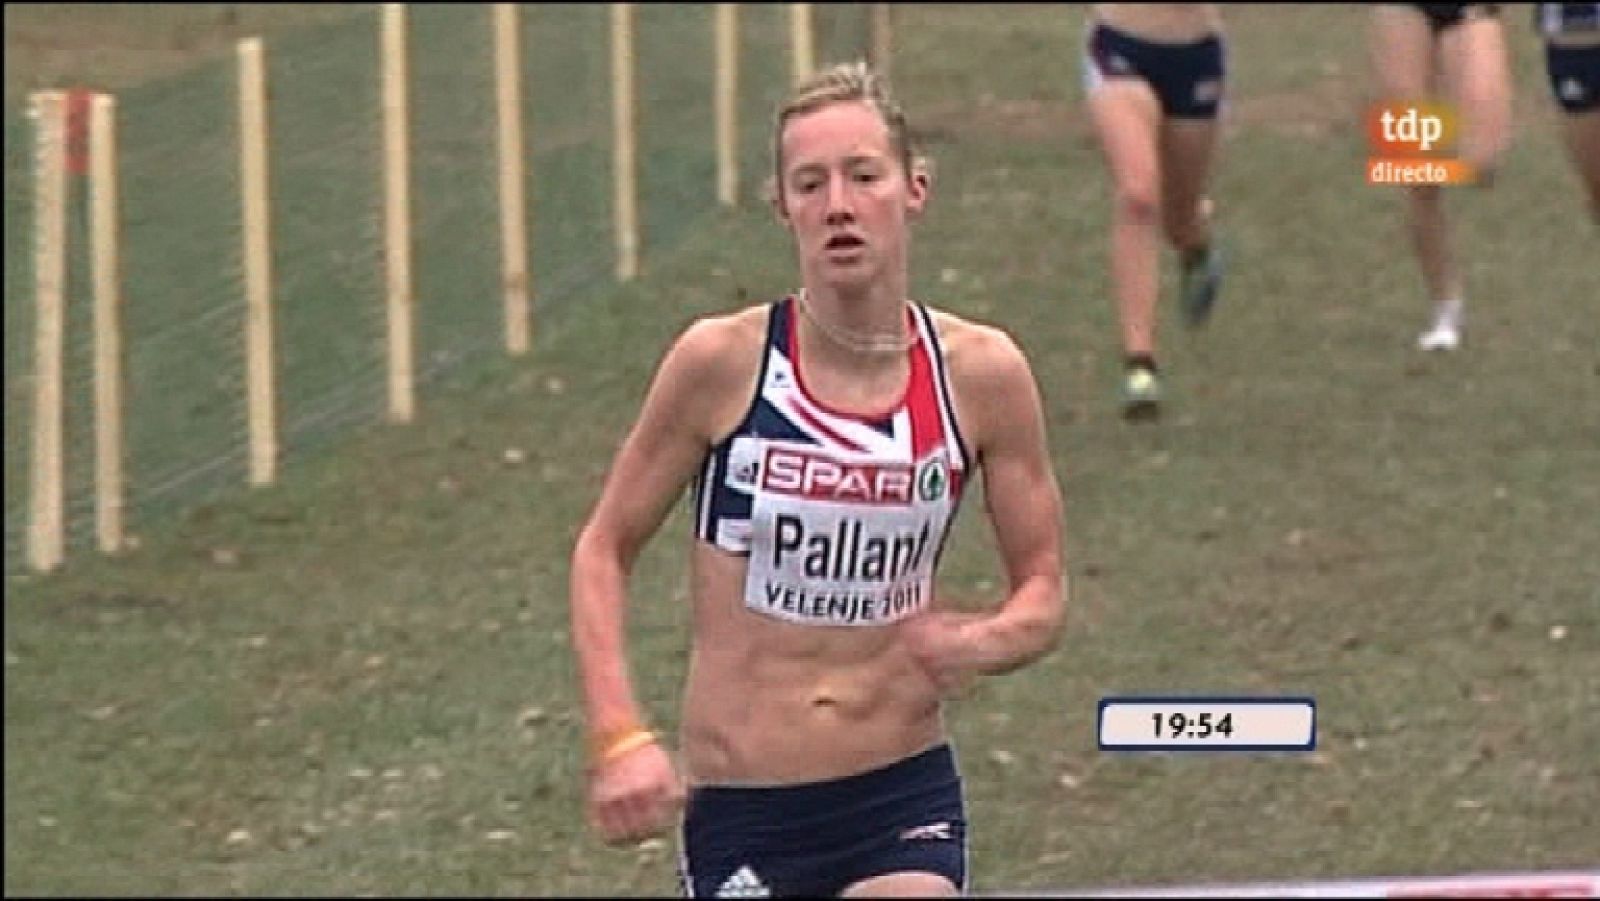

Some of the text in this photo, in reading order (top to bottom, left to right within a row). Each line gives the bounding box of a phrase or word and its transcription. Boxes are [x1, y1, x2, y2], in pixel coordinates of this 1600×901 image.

[766, 453, 912, 501] SPAR
[775, 513, 930, 582] Pallant
[766, 582, 922, 622] VELENJE 2011
